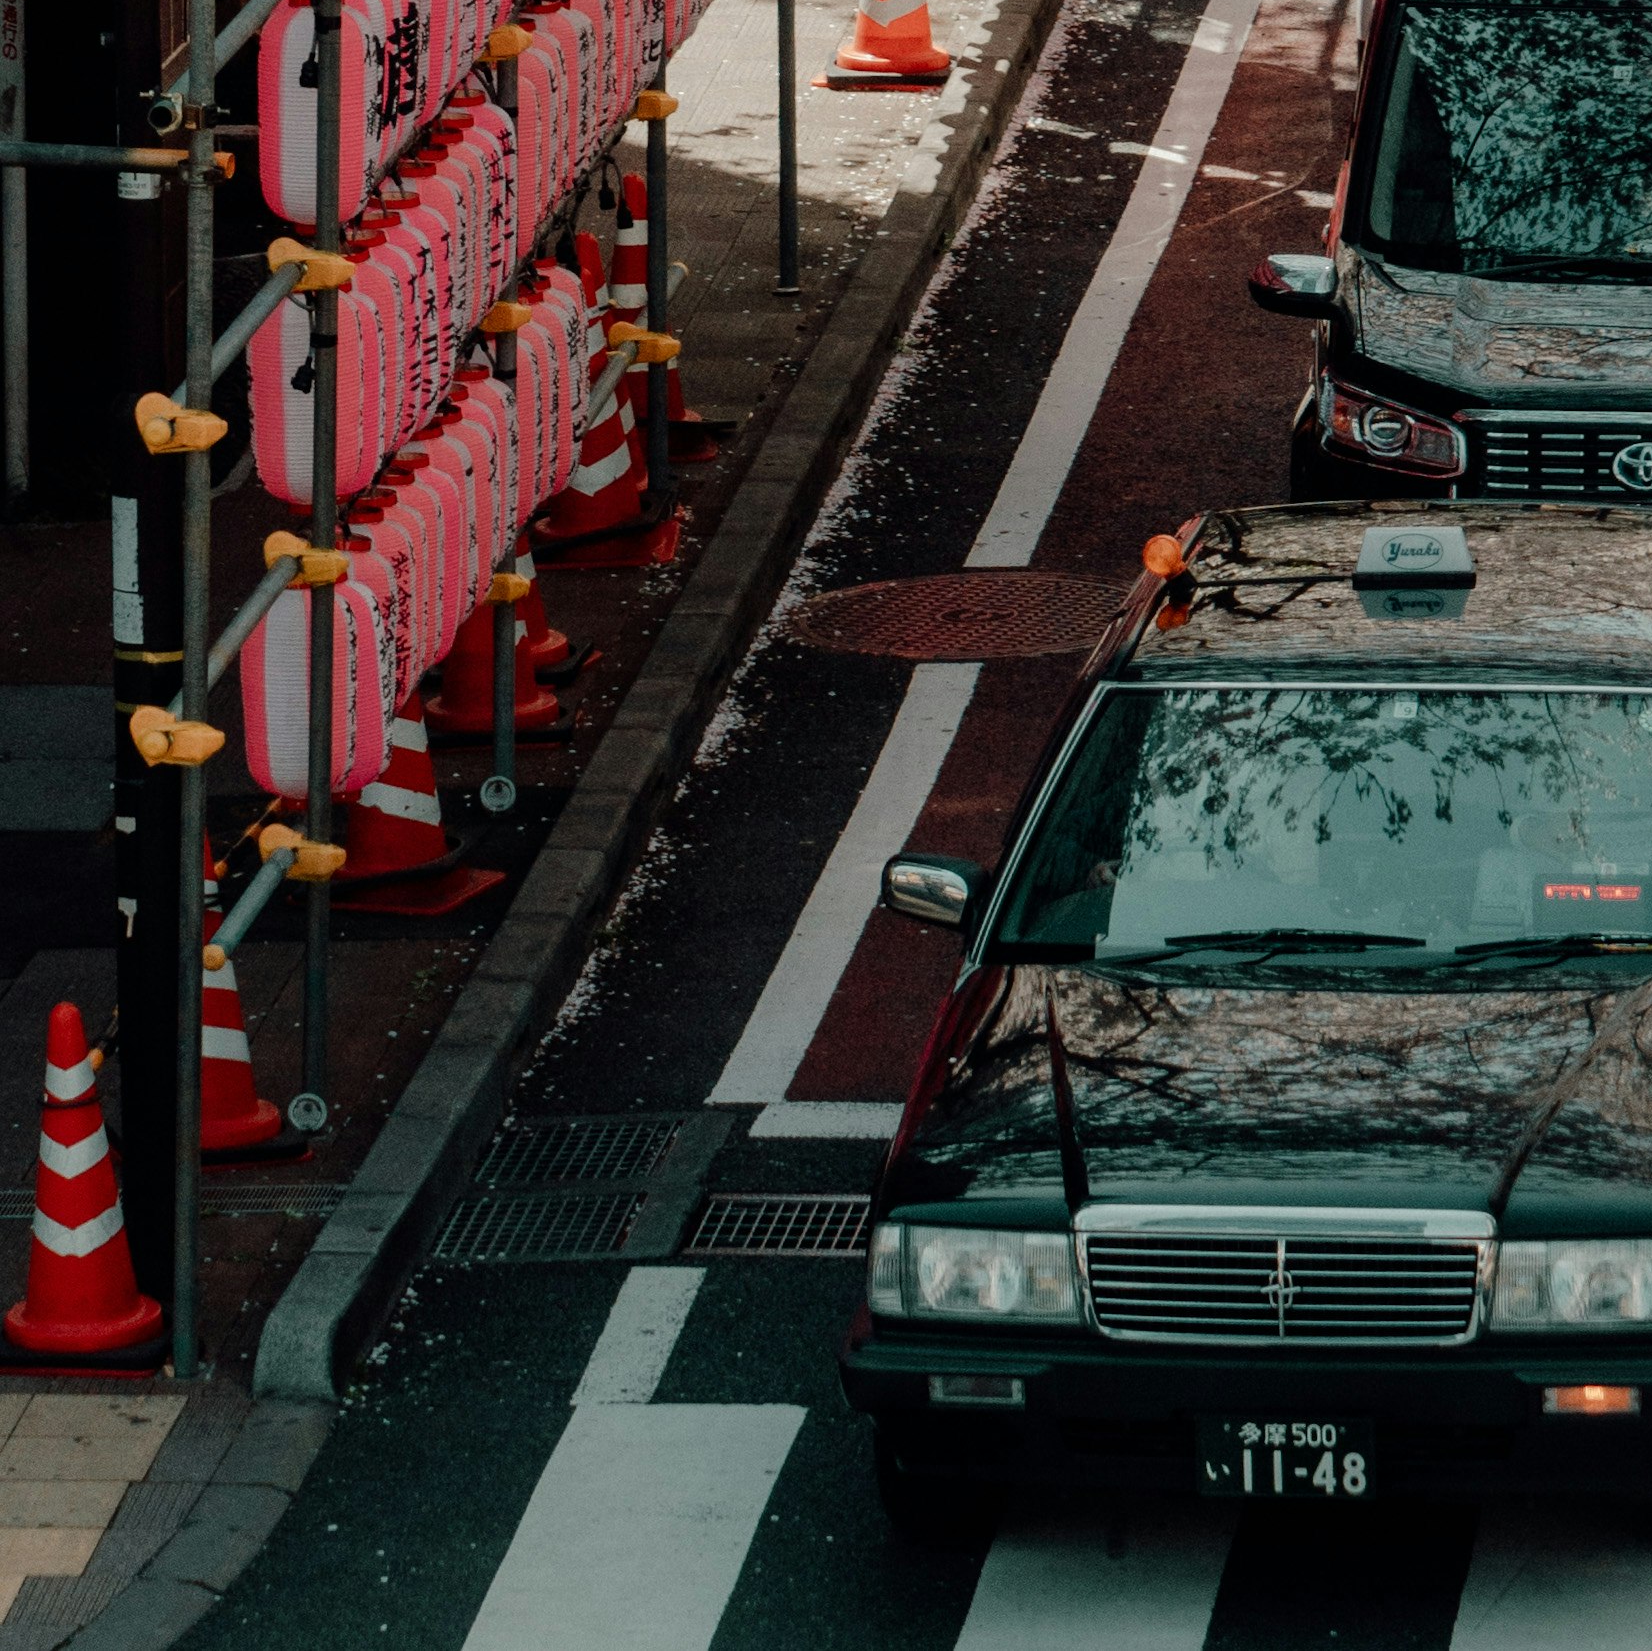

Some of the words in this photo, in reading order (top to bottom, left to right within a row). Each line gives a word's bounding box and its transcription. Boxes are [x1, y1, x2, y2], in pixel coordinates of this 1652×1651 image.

[1387, 542, 1440, 562] Yuraku
[1238, 1422, 1287, 1446] 多摩
[1291, 1423, 1337, 1447] 500
[1205, 1460, 1231, 1482] い
[1243, 1448, 1367, 1496] 11-48
